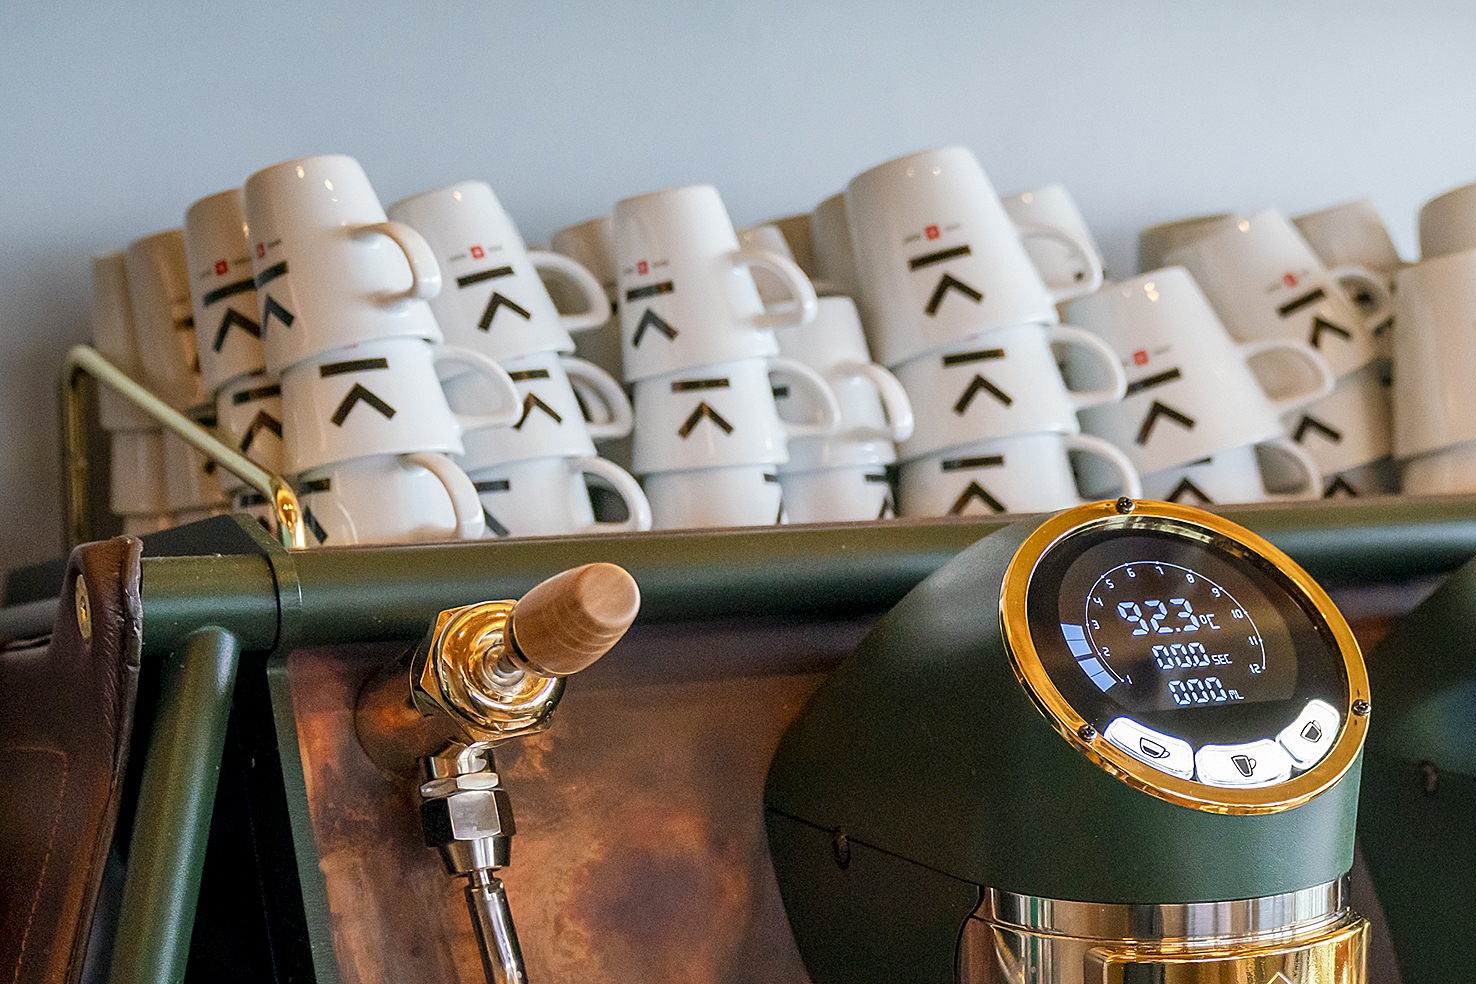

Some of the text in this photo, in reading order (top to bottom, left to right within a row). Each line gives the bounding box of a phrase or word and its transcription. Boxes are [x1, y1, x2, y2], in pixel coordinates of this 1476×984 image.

[1126, 567, 1136, 578] 6
[1154, 565, 1164, 575] 7
[1105, 578, 1115, 589] 5
[1186, 573, 1195, 584] 8
[1211, 587, 1221, 598] 9
[1092, 596, 1104, 607] 4
[1117, 598, 1200, 636] 92.3
[1231, 608, 1244, 619] 10
[1091, 619, 1101, 630] 3
[1248, 635, 1259, 646] 11
[1102, 646, 1111, 657] 2
[1211, 653, 1233, 666] SEC
[1248, 663, 1262, 674] 12
[1125, 674, 1133, 685] 1
[1168, 676, 1227, 705] 000
